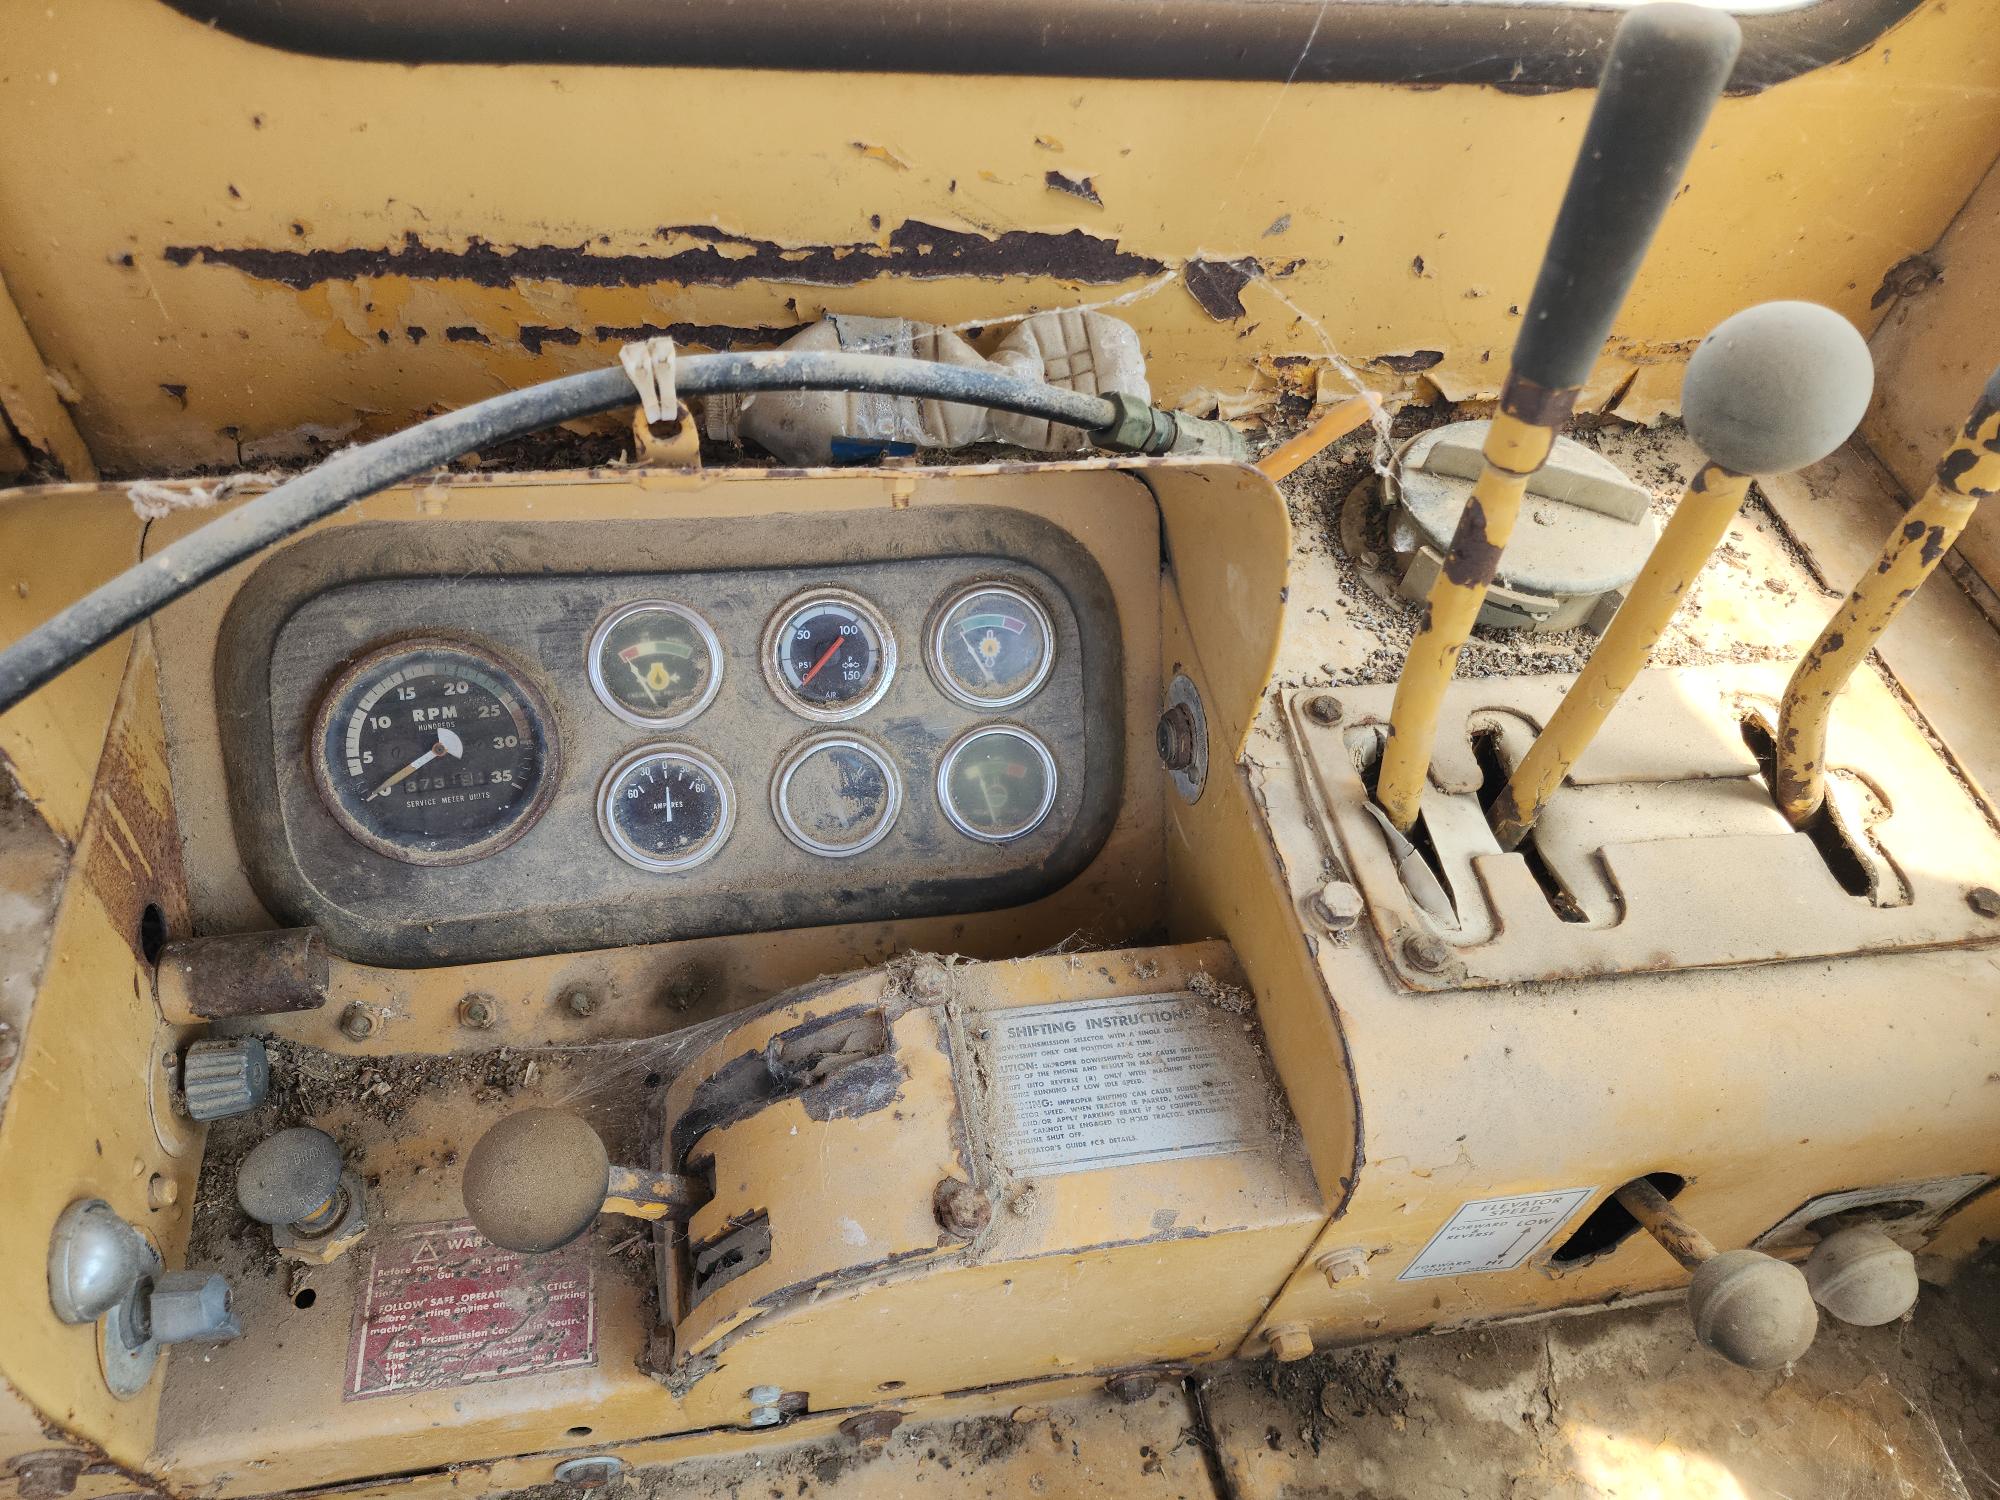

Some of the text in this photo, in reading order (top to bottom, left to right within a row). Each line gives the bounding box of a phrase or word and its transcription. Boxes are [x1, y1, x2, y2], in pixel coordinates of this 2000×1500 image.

[796, 630, 810, 640] 50
[840, 625, 858, 635] 100
[843, 671, 860, 680] 150
[397, 686, 416, 700] 15
[443, 680, 469, 696] 20
[412, 705, 458, 722] RPM
[478, 704, 500, 718] 25
[370, 716, 392, 730] 10
[418, 722, 456, 731] HUNDREDS
[493, 736, 518, 749] 30
[363, 751, 374, 764] 5
[662, 761, 668, 770] 0
[640, 767, 650, 776] 30
[490, 770, 512, 784] 35
[695, 784, 706, 793] 60
[628, 790, 638, 799] 60
[406, 798, 436, 808] SERVICE
[653, 801, 683, 810] AMPRES
[1008, 1021, 1076, 1038] SHIFTING
[1086, 1009, 1192, 1030] INSTRUCTIONS
[1019, 1038, 1070, 1049] TRANSMISSION
[1074, 1035, 1104, 1043] SELECTOR
[1108, 1032, 1126, 1040] WITH
[1081, 1043, 1113, 1052] POSITION
[1156, 1049, 1177, 1057] CAUSE
[1053, 1067, 1078, 1075] ENGINE
[1085, 1075, 1096, 1083] (R)
[1104, 1072, 1122, 1080] ONLY
[1129, 1069, 1146, 1077] WITH
[1152, 1065, 1183, 1074] MACHINE
[1034, 1087, 1067, 1096] RUNNING
[1058, 1097, 1092, 1105] IMPROPER
[1151, 1087, 1172, 1095] CAUSE
[1096, 1102, 1126, 1110] TRACTOR
[1083, 1111, 1115, 1119] PARKING
[1033, 1126, 1063, 1135] CANNOT
[1080, 1120, 1112, 1128] ENGAGED
[1480, 1197, 1563, 1212] ELEVATOR
[1489, 1206, 1541, 1217] SPEED
[1450, 1221, 1508, 1232] FORWARD
[1516, 1218, 1554, 1227] LOW
[1446, 1231, 1496, 1240] REVERSE
[1414, 1260, 1471, 1270] FORWARD
[430, 1296, 455, 1306] SAFE
[454, 1303, 489, 1314] engine
[420, 1329, 488, 1344] Transmission
